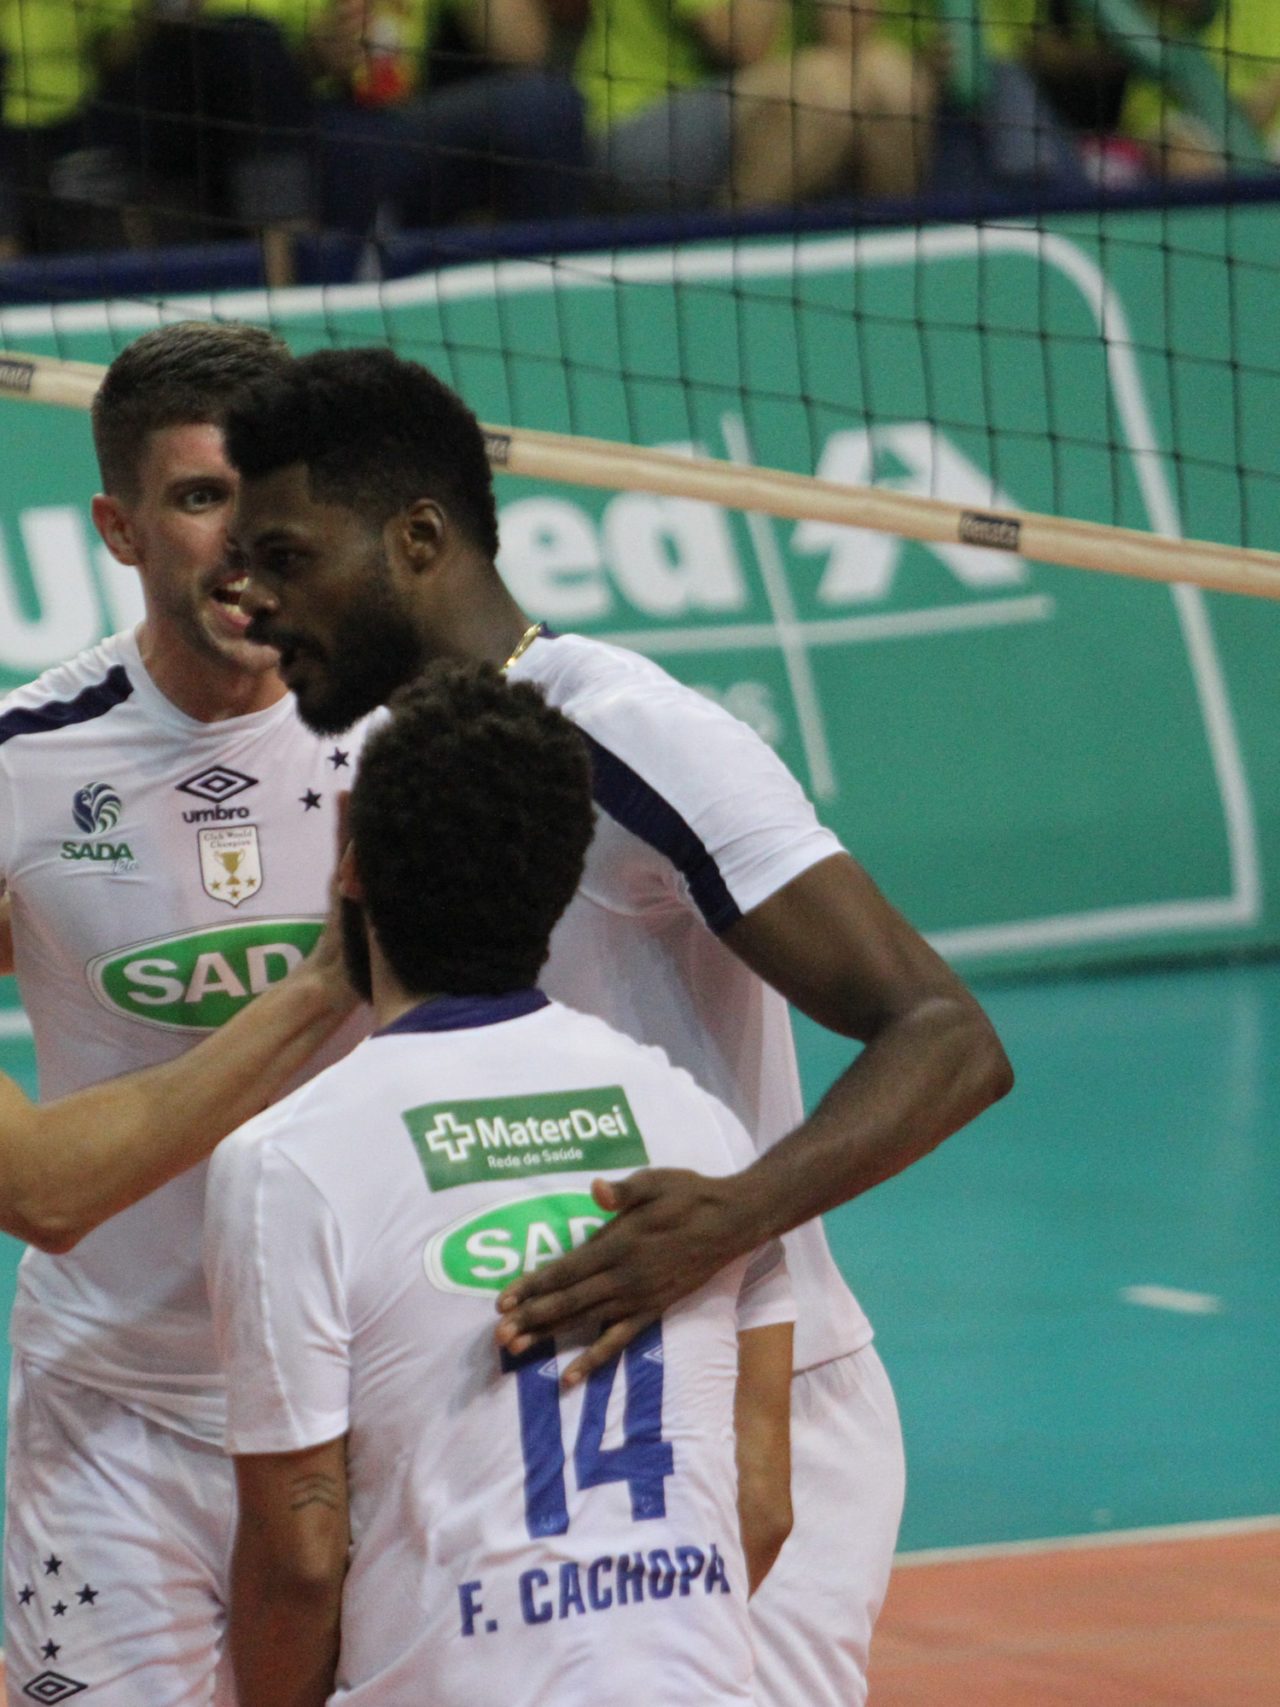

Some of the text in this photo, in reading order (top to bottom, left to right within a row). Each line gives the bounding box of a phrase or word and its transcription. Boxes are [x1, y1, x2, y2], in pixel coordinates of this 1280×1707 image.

[182, 804, 250, 824] umbro
[60, 841, 135, 862] SADA
[122, 941, 306, 1006] SAD
[475, 1105, 630, 1150] MaterDei
[487, 1147, 584, 1169] Rede de Saúde
[501, 1318, 675, 1540] 14
[457, 1543, 733, 1637] F. CACHOPA
